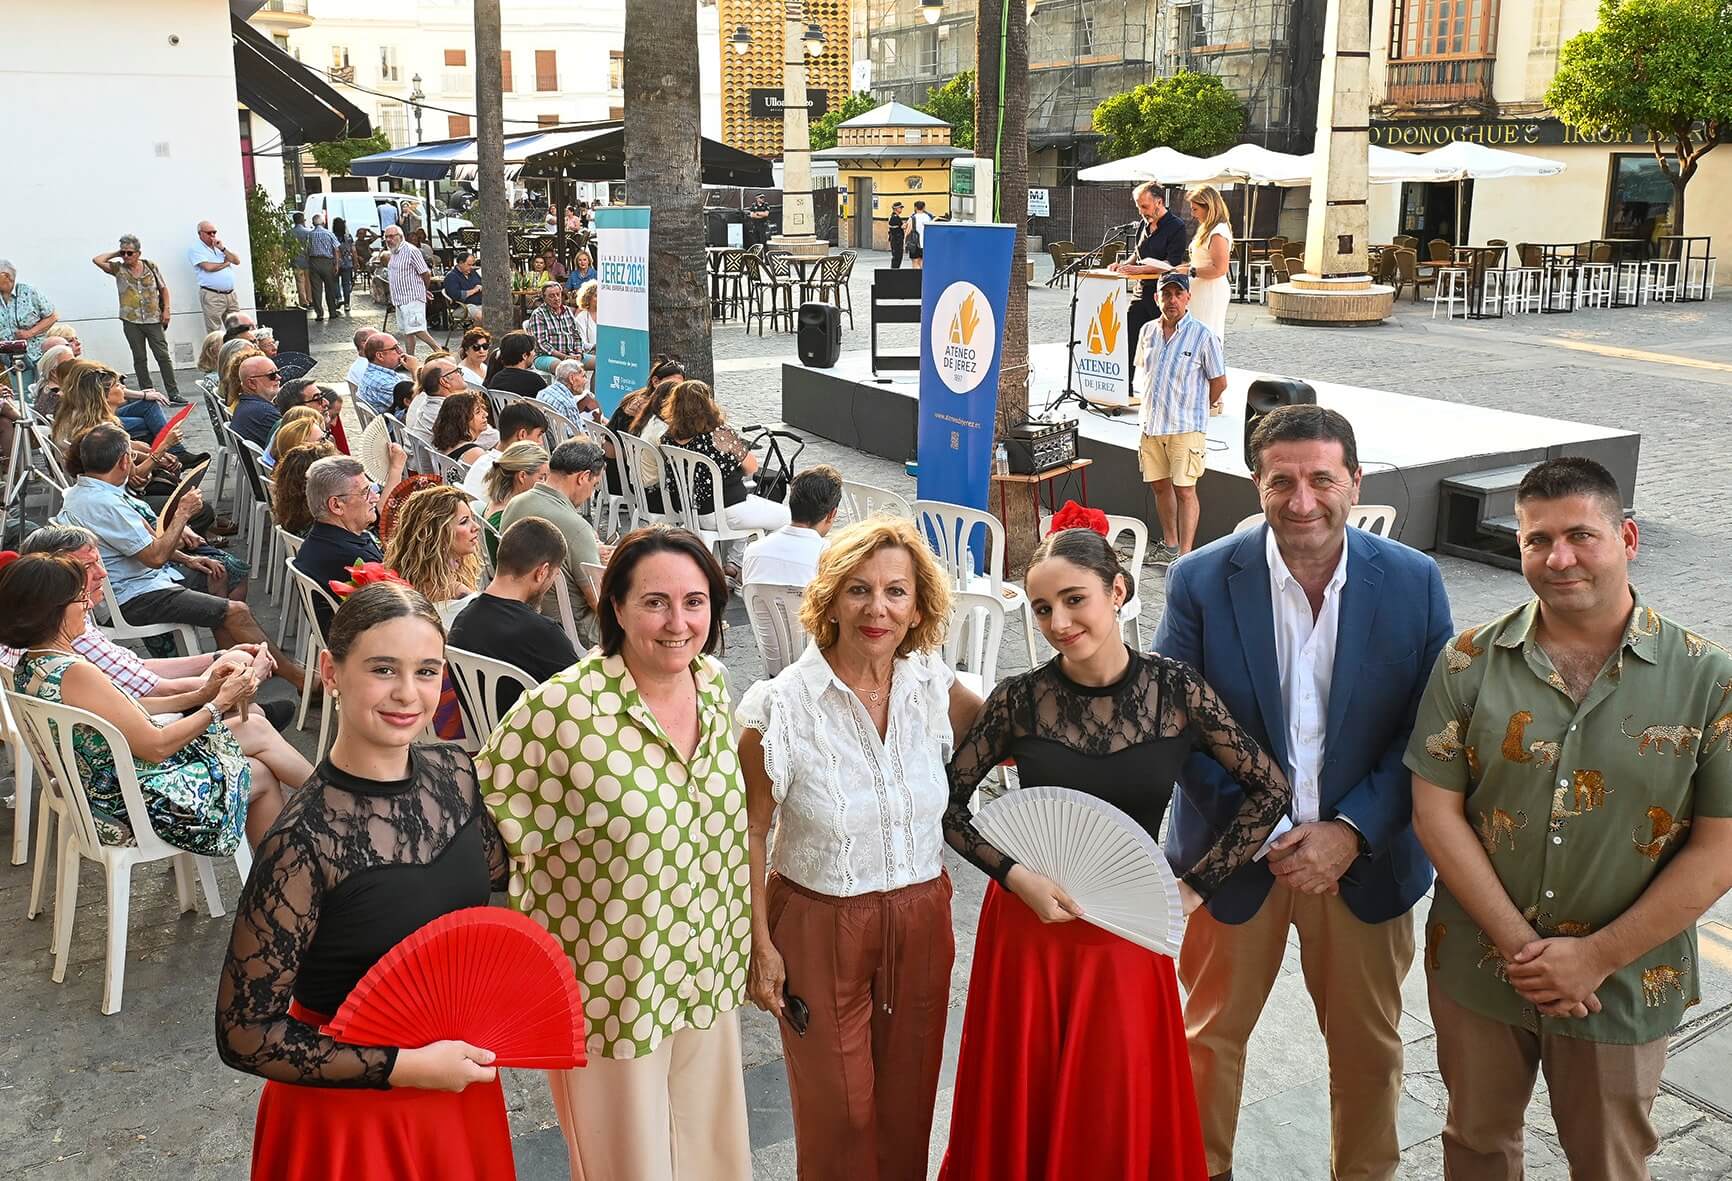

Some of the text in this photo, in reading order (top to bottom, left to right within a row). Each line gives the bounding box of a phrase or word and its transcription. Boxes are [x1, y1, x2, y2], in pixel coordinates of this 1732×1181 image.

[601, 261, 646, 287] JEREZ 2031
[945, 345, 976, 361] ATENEO
[943, 357, 977, 373] DE JEREZ
[1079, 358, 1120, 376] ATENEO
[1084, 378, 1115, 393] DE JEREZ
